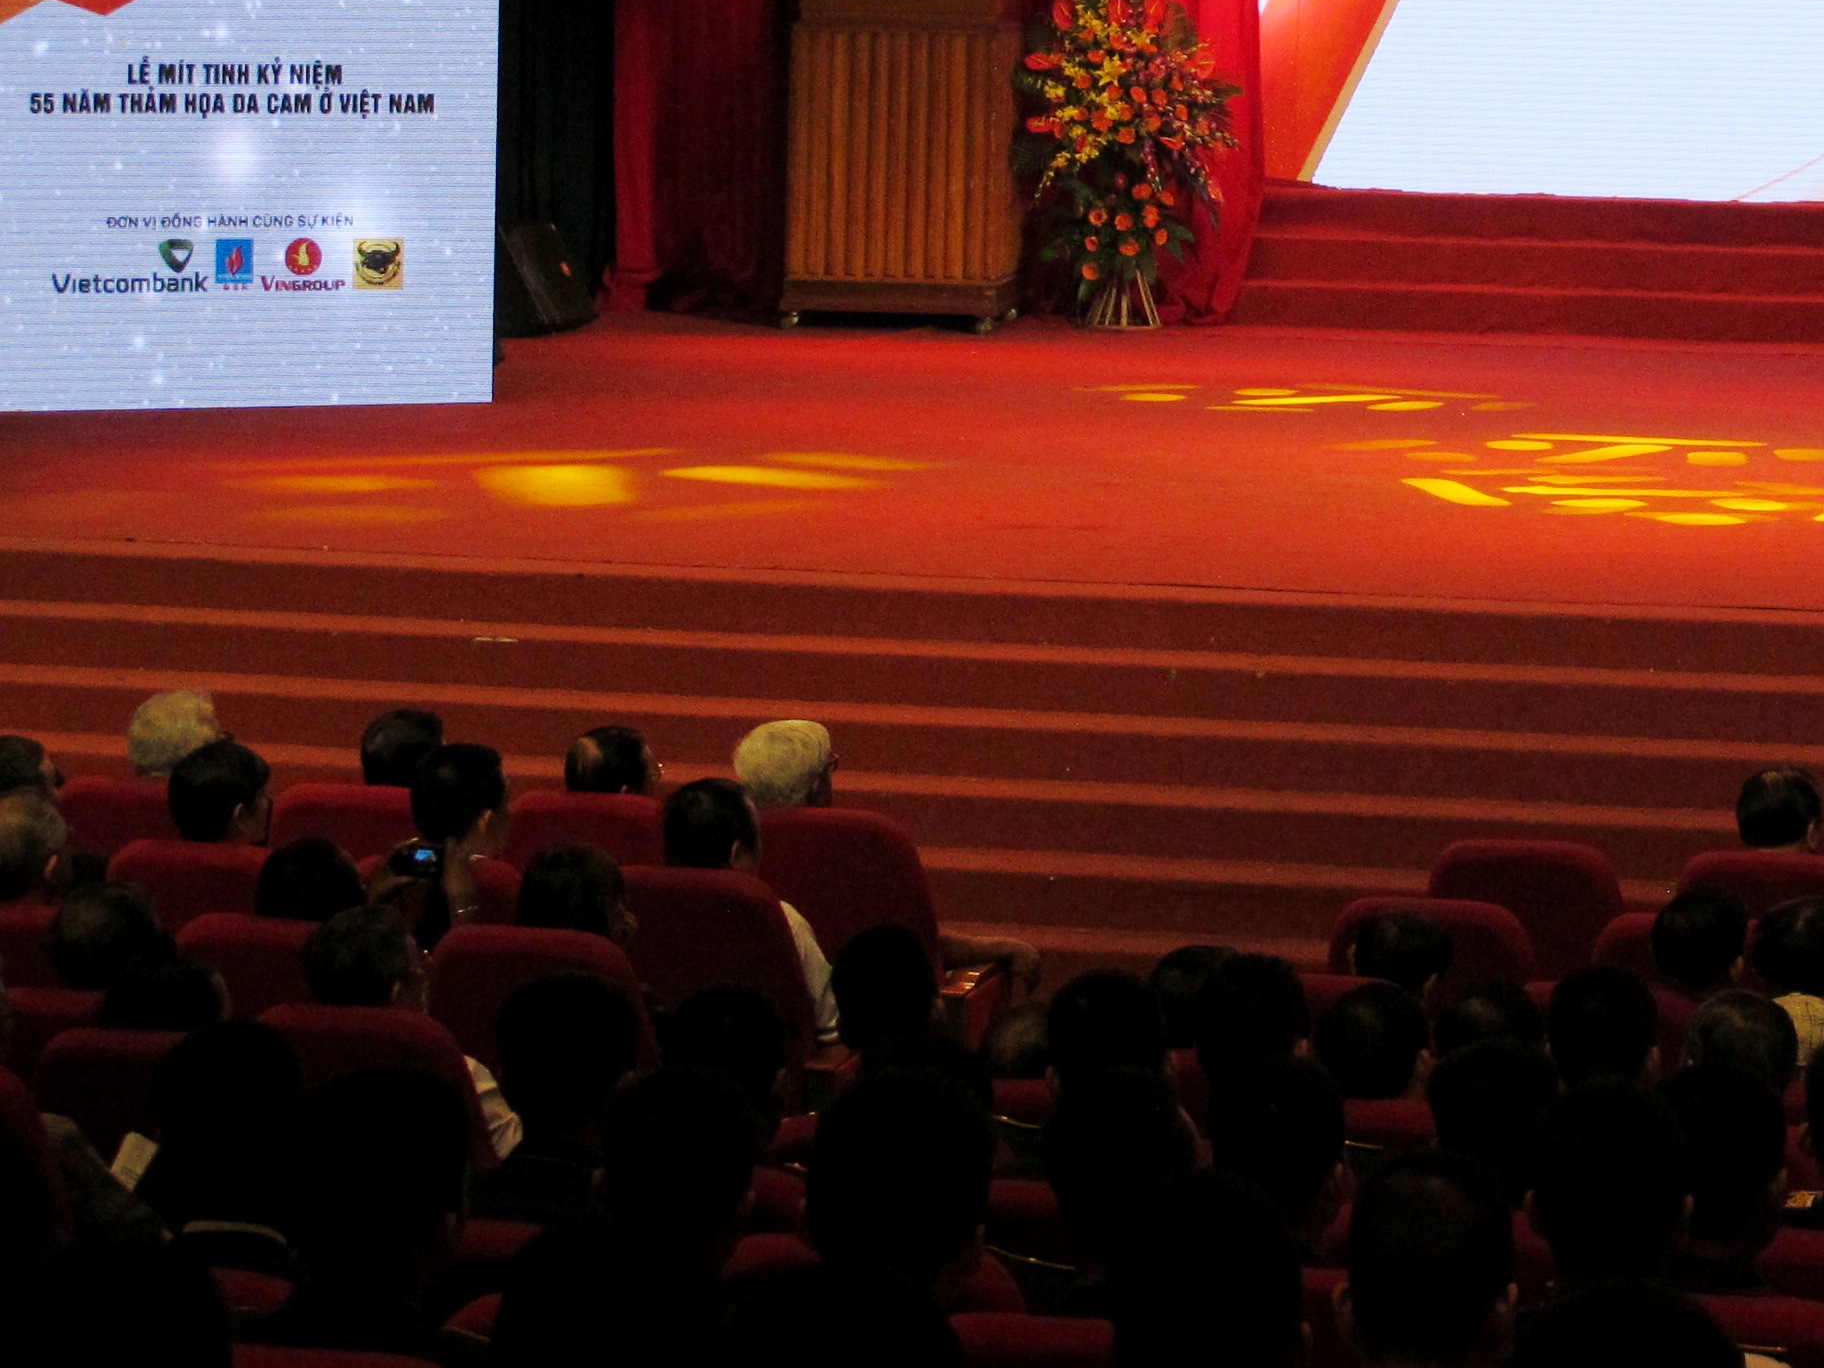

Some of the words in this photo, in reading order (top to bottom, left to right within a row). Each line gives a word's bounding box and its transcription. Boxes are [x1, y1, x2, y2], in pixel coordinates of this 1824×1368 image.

[159, 59, 196, 85] MÍT
[203, 63, 249, 85] TINH
[257, 57, 283, 85] KỶ
[290, 60, 343, 90] NIỆM
[30, 93, 54, 114] 55
[62, 88, 111, 114] NĂM
[119, 86, 177, 114] THẢM
[184, 92, 226, 120] HỌA
[233, 93, 259, 114] DA
[267, 93, 312, 114] CAM
[340, 89, 382, 119] VIỆT
[389, 93, 435, 114] NAM
[52, 272, 208, 294] Vietcombank
